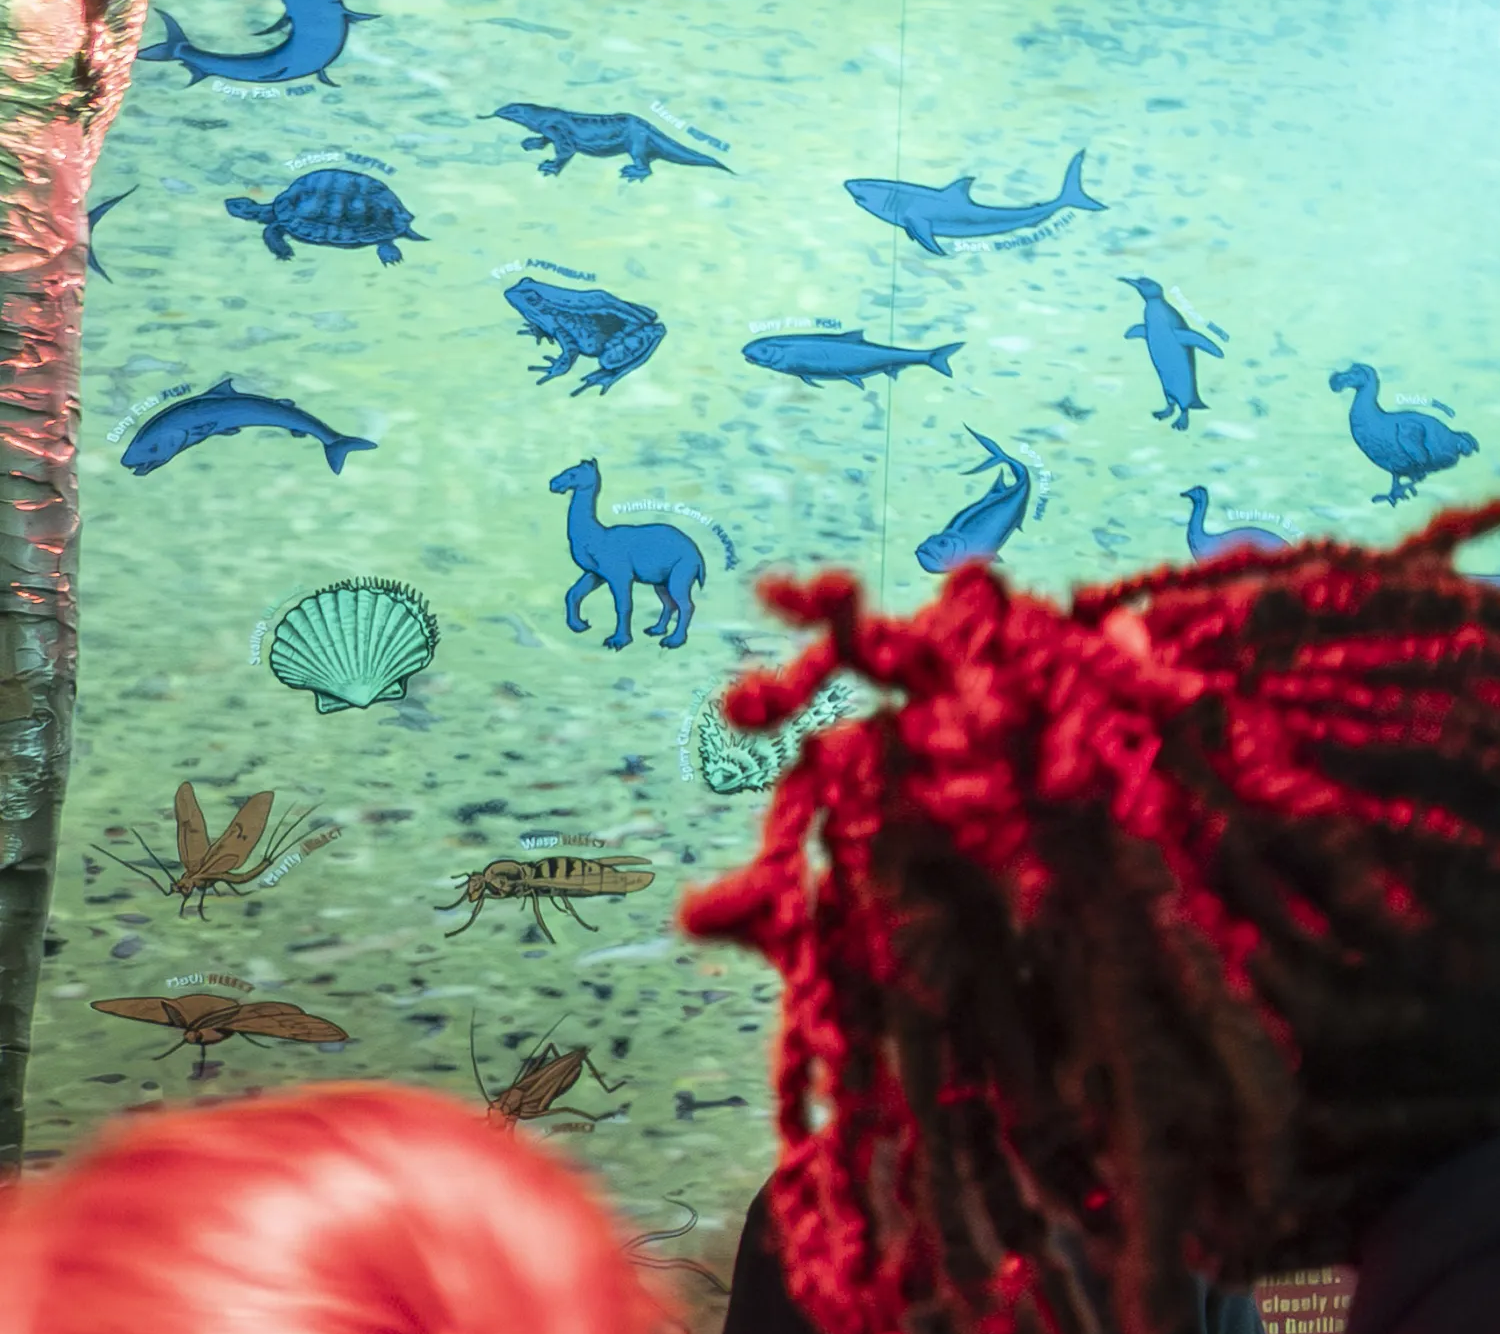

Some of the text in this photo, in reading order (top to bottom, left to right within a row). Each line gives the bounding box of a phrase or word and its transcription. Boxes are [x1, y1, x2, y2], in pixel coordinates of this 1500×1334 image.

[954, 240, 991, 253] Shark
[612, 499, 671, 515] Primitive
[672, 502, 712, 526] Camel
[1227, 508, 1280, 524] Elephant
[248, 621, 268, 666] Scallop
[520, 835, 558, 850] Wasp
[1262, 1292, 1328, 1315] closely
